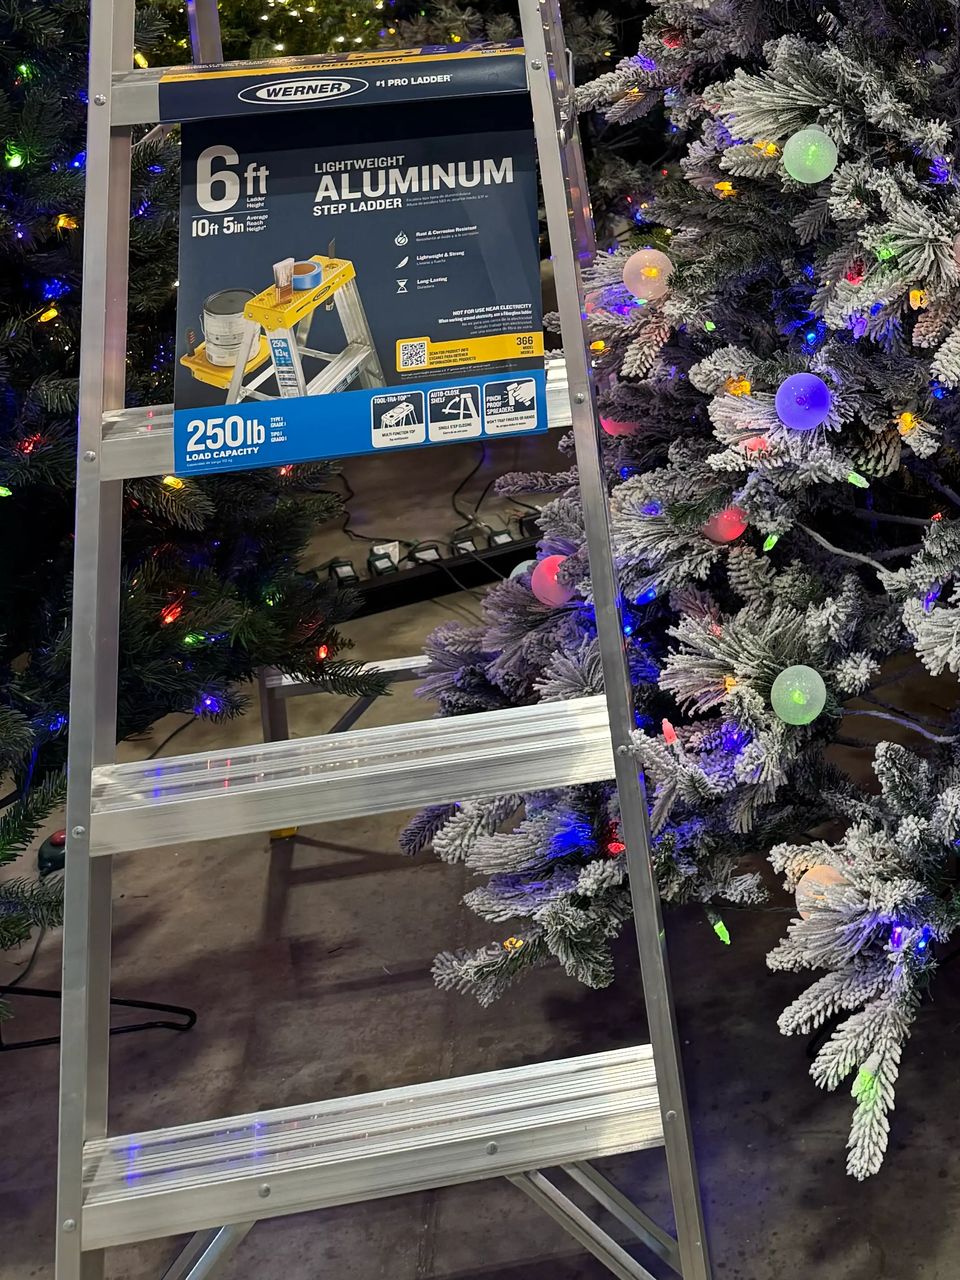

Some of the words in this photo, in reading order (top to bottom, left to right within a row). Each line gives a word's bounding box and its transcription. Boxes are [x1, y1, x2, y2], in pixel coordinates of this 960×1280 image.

[375, 80, 386, 88] #1
[387, 77, 408, 87] PRO
[411, 74, 451, 85] LADDER
[265, 82, 344, 98] WERNER
[314, 155, 406, 174] LIGHTWEIGHT
[314, 156, 514, 203] ALUMINUM
[313, 203, 347, 217] STEP
[350, 198, 403, 213] LADDER
[416, 253, 444, 261] Lightweight
[516, 336, 534, 346] 366
[430, 389, 460, 398] AUTO-CLOSE
[486, 406, 515, 415] SPREADERS
[186, 452, 212, 462] LOAD
[213, 446, 259, 459] CAPACITY
